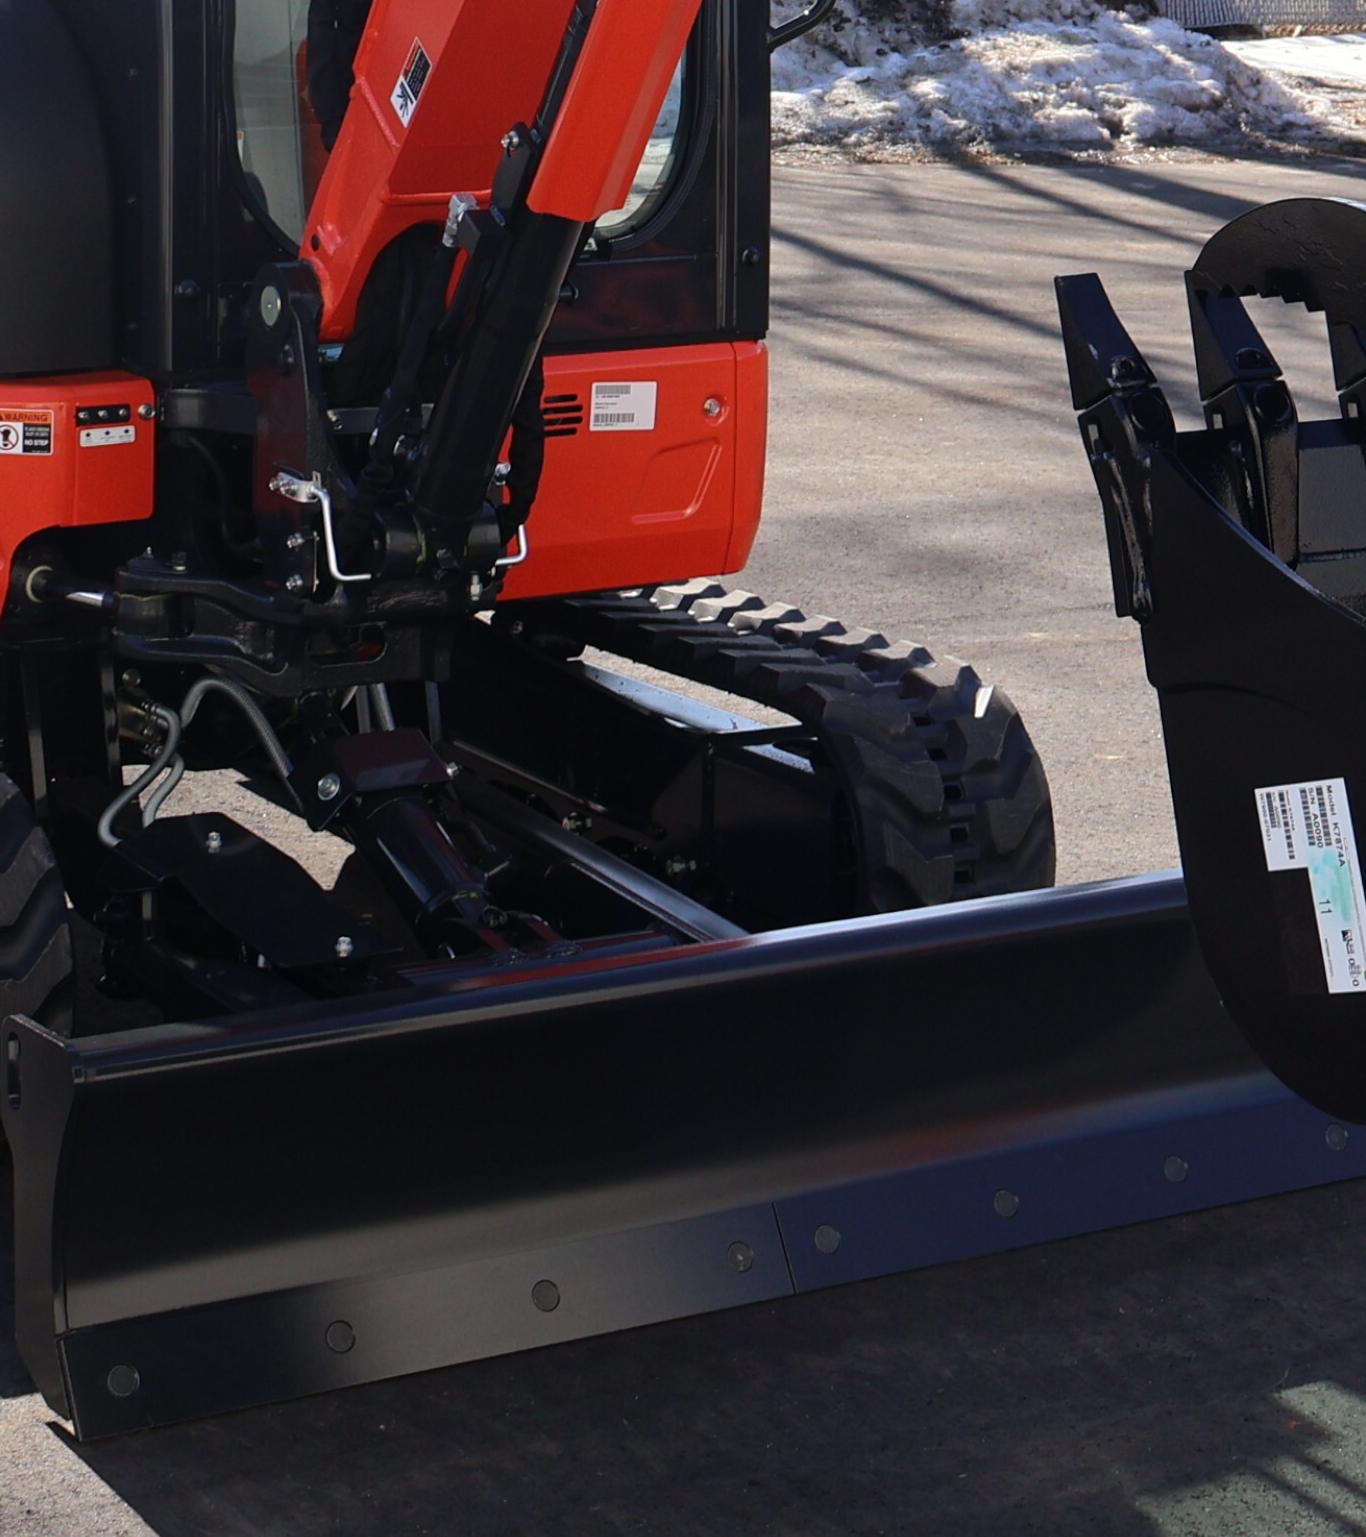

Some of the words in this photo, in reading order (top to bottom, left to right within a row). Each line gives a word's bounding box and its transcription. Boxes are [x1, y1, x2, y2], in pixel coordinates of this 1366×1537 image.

[4, 413, 48, 422] WARNING
[1326, 785, 1337, 816] Model
[1332, 822, 1346, 867] K7874A
